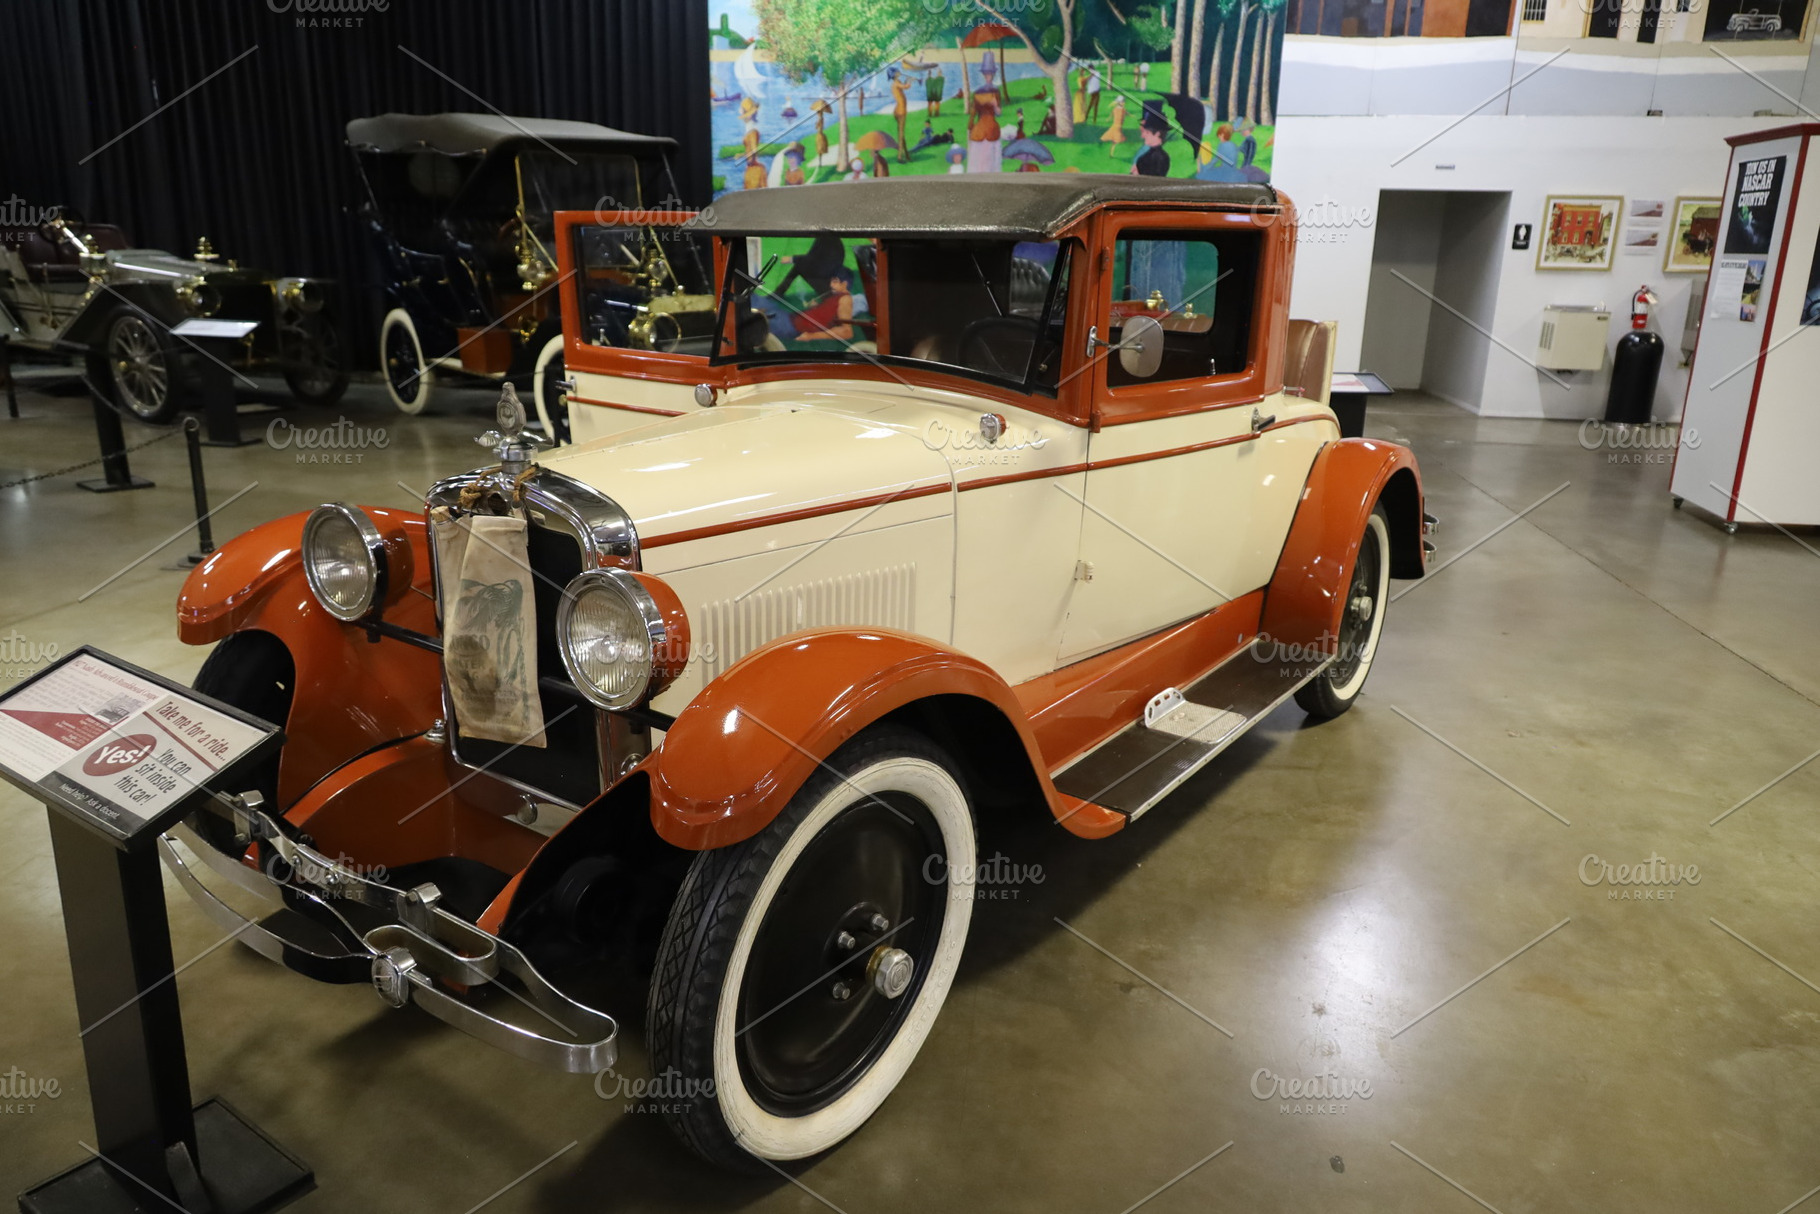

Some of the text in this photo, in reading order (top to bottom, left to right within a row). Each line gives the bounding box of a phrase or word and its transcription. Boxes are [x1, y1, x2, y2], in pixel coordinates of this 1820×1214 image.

[1745, 158, 1777, 175] JOIN US IN
[1741, 173, 1774, 192] NASCAR
[1738, 190, 1770, 207] COUNTRY
[156, 701, 229, 761] Take me for a ride...
[93, 745, 152, 764] Yes!
[156, 748, 192, 776] You can
[114, 775, 157, 806] this car!
[135, 764, 176, 793] sit inside
[59, 783, 76, 794] Need
[73, 789, 89, 800] help?
[86, 798, 99, 808] Ask
